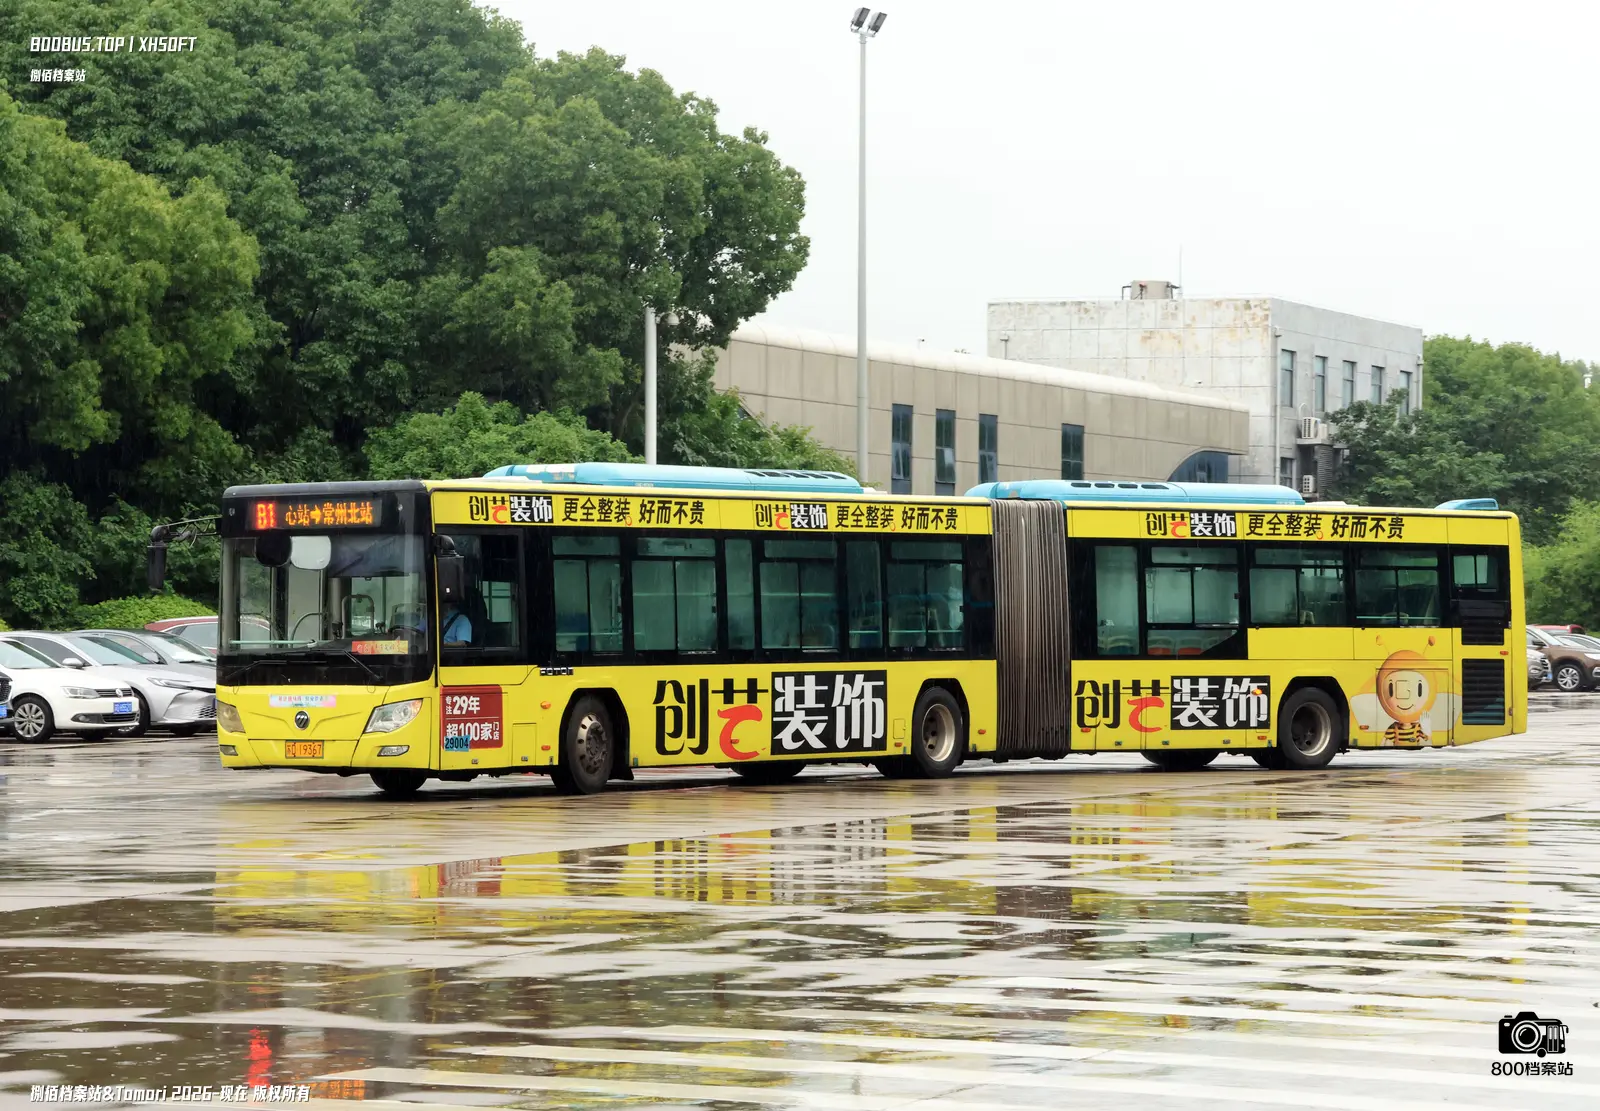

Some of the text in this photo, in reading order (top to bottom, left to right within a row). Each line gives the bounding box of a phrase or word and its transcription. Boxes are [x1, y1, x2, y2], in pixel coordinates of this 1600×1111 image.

[256, 503, 275, 529] B1
[285, 502, 372, 526] 心站 常州北站
[469, 495, 705, 524] 创艺装饰 更全整装 好而不贵
[755, 503, 958, 530] 创艺装饰 更全整装 好而不贵
[1146, 512, 1404, 540] 创艺装饰 更全整装 好而不贵
[453, 695, 480, 715] 29年
[652, 674, 885, 760] 创艺装饰
[1075, 678, 1268, 732] 创艺装饰
[444, 737, 469, 749] 29004
[446, 721, 492, 741] 超100家
